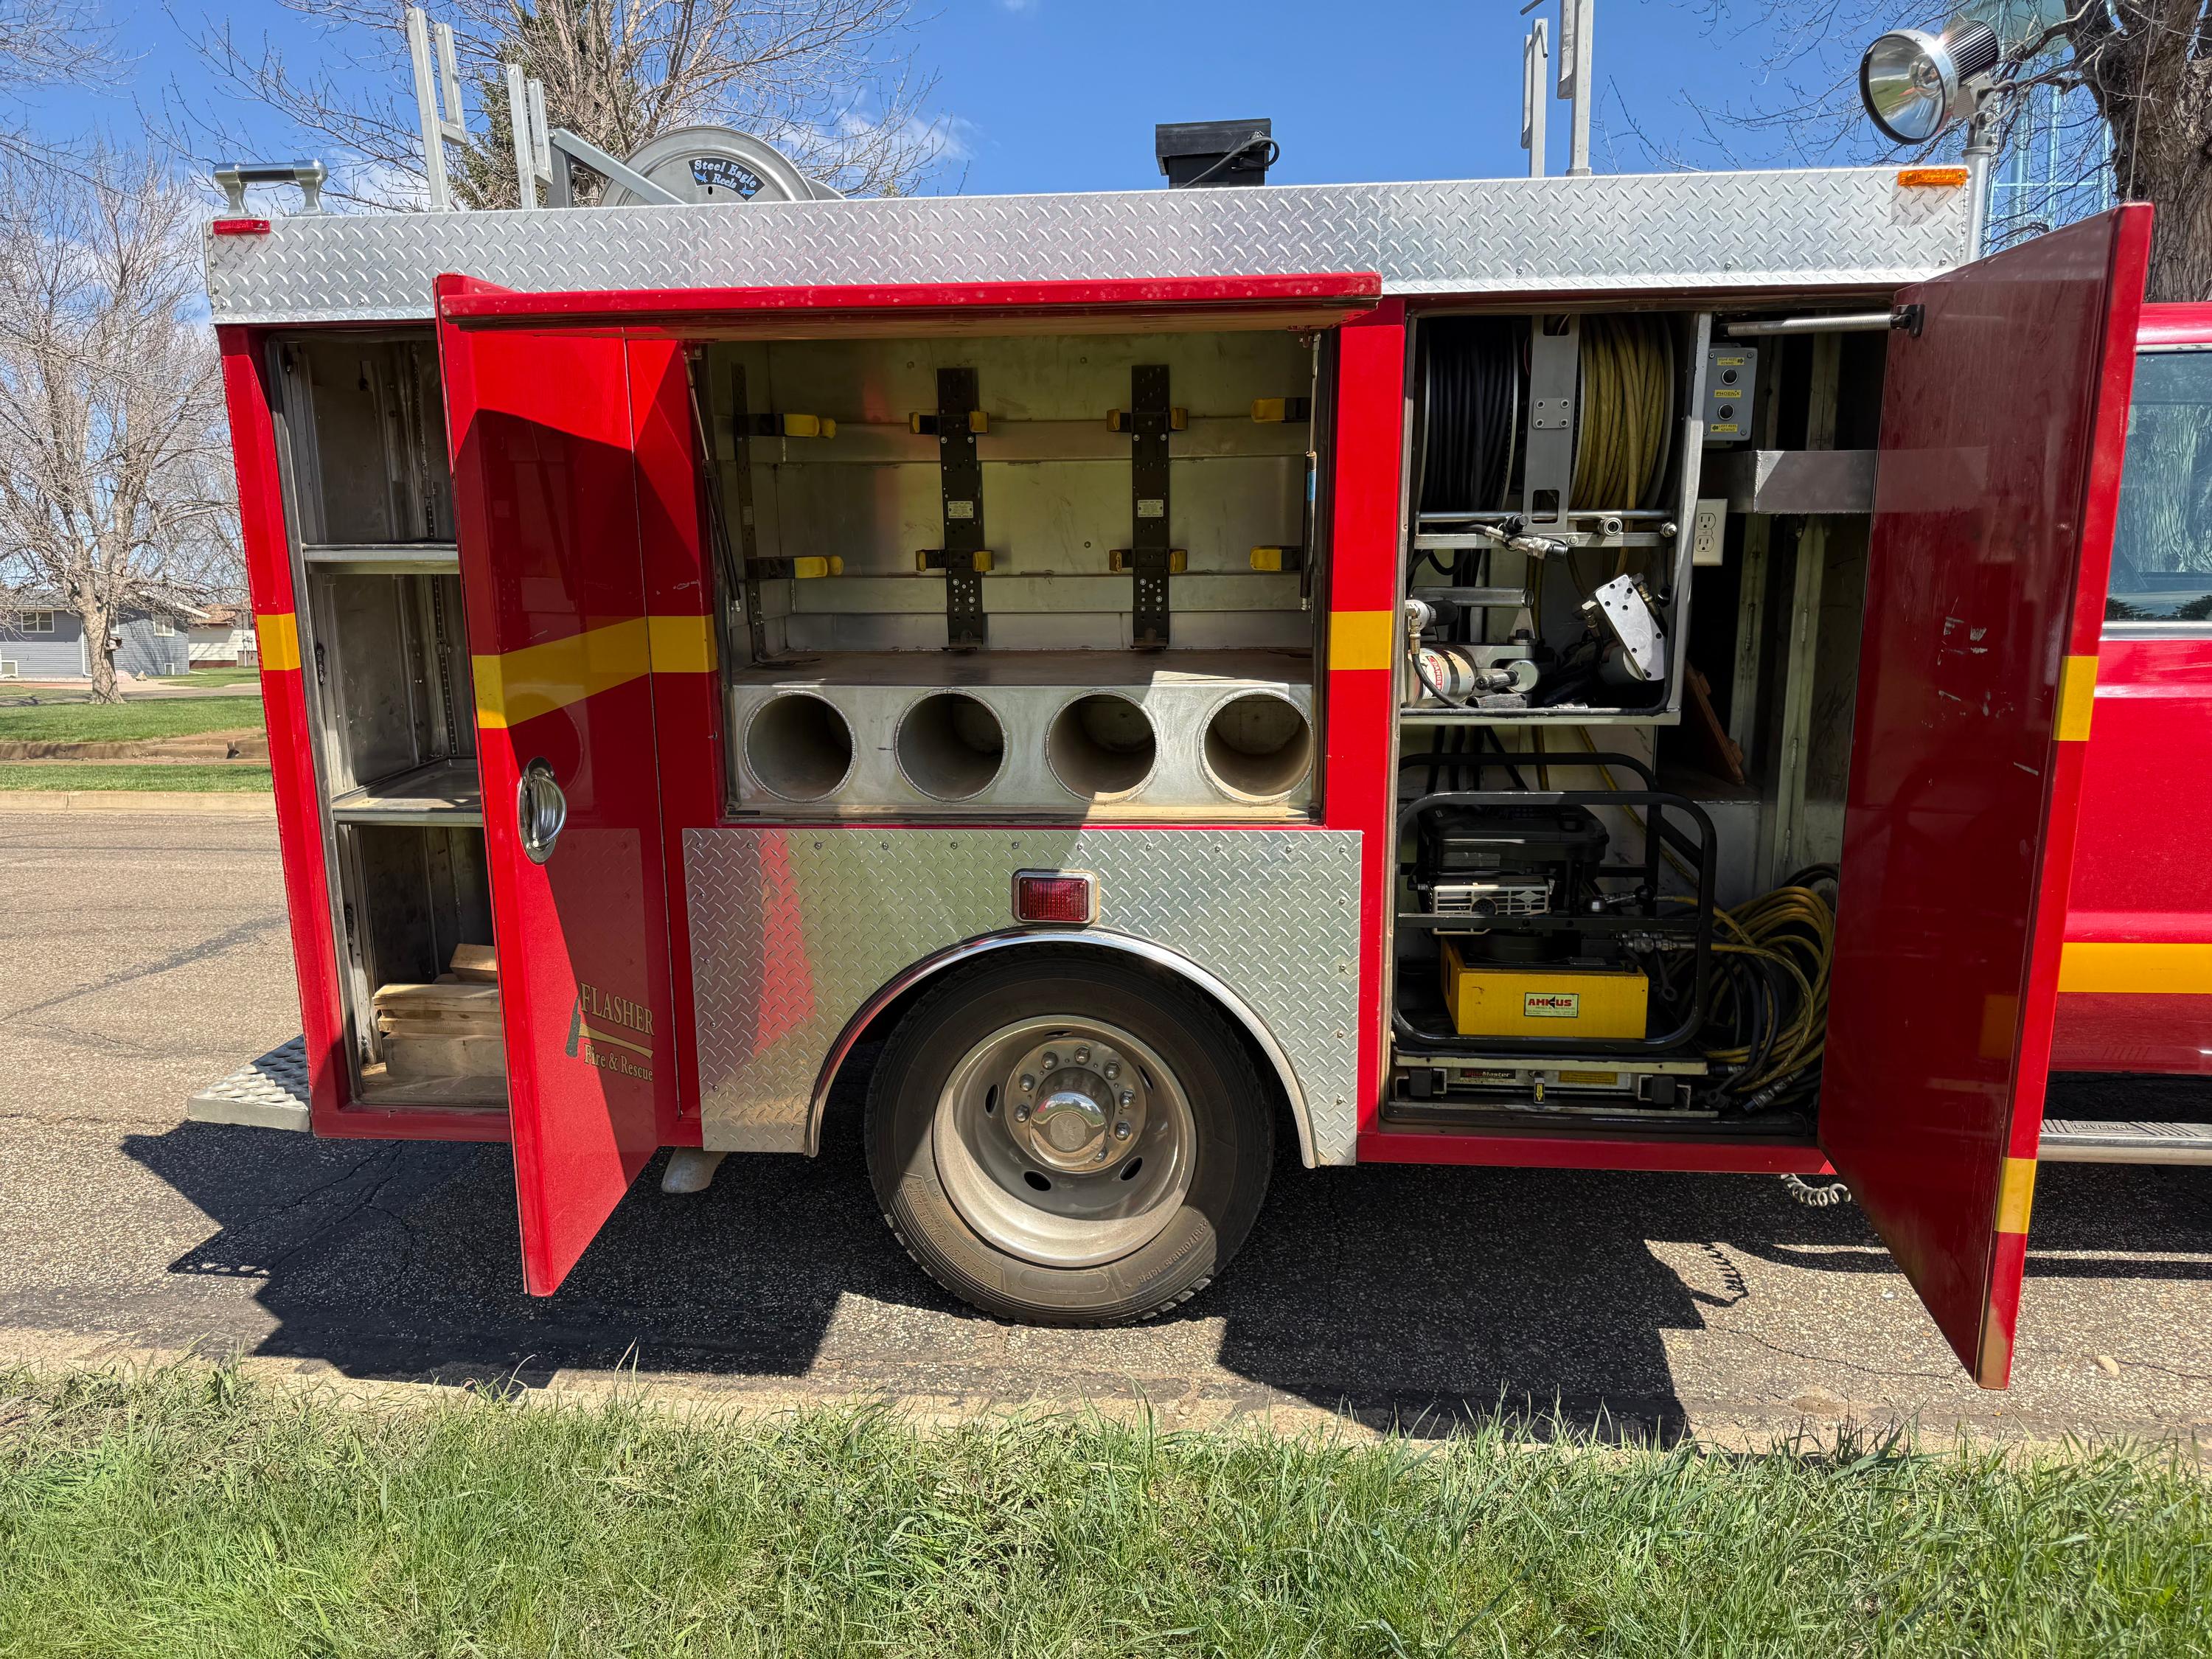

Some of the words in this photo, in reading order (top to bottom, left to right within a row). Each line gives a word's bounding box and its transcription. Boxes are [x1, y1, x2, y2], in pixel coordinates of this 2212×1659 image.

[694, 159, 727, 173] Steel
[728, 164, 757, 188] Eagle
[712, 173, 737, 189] Reels
[580, 983, 655, 1035] FLASHER
[1528, 996, 1572, 1009] AMKUS
[584, 1043, 605, 1068] Fire
[609, 1053, 618, 1071] &
[621, 1055, 653, 1082] Rescue
[917, 1208, 999, 1285] TRANSFORCE
